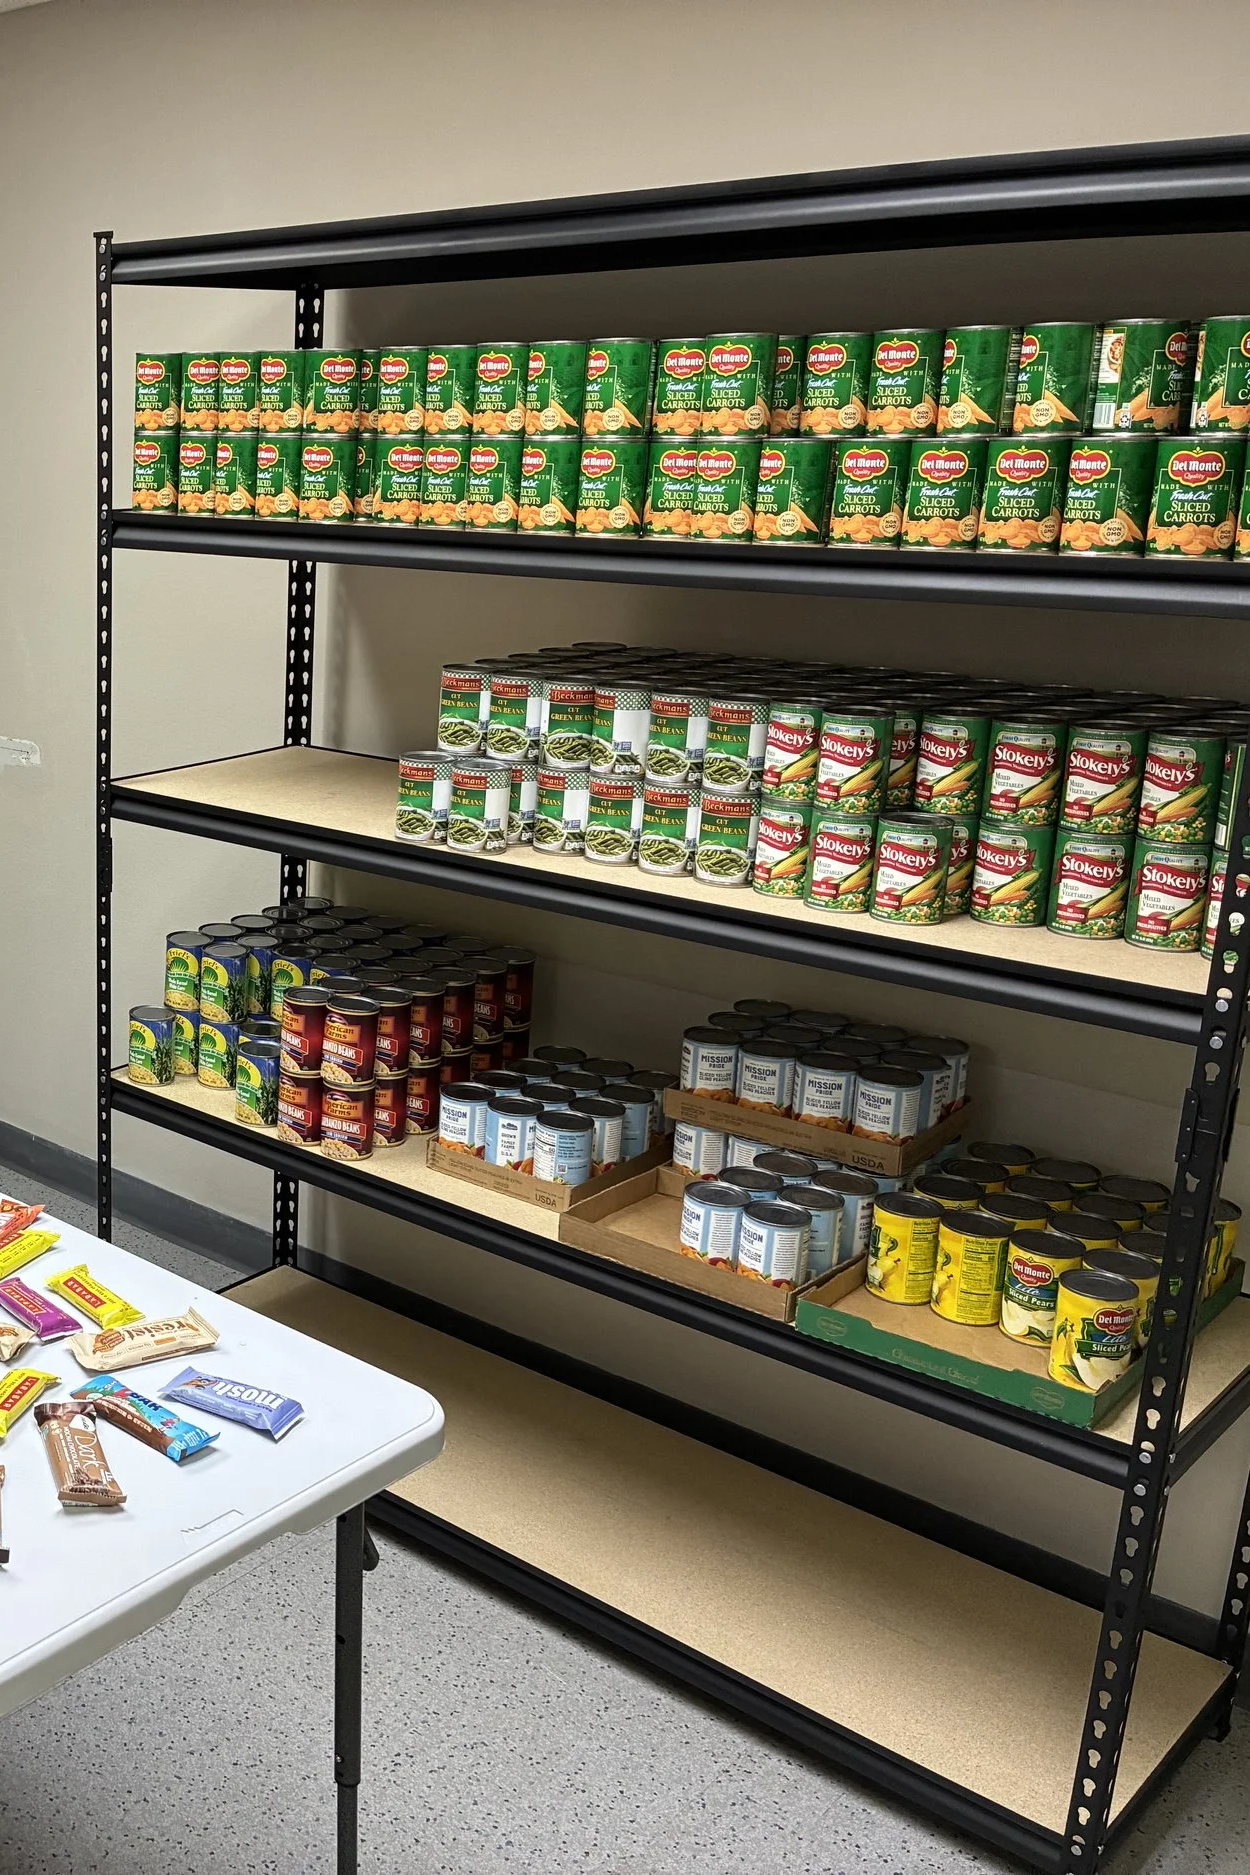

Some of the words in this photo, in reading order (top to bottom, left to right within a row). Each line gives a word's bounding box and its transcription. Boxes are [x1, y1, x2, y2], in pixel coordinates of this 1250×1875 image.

[712, 354, 723, 363] Del
[724, 353, 748, 363] Monte
[877, 351, 888, 360] Del
[889, 350, 916, 360] Monte
[323, 364, 334, 373] Del
[335, 364, 355, 374] Monte
[711, 389, 740, 398] SLICED
[807, 388, 834, 398] SLICED
[876, 387, 906, 396] SLICED
[324, 395, 350, 403] SLICED
[706, 397, 745, 407] CARROTS
[803, 396, 839, 407] CARROTS
[872, 395, 912, 406] CARROTS
[320, 401, 353, 410] CARROTS
[845, 457, 856, 467] Del
[858, 458, 886, 468] Monte
[1000, 458, 1012, 469] Del
[1013, 459, 1046, 470] Monte
[1172, 459, 1185, 471] Del
[1186, 460, 1222, 472] Monte
[844, 494, 875, 504] SLICED
[998, 496, 1035, 508] SLICED
[838, 503, 881, 514] CARROTS
[991, 506, 1040, 518] CARROTS
[1170, 501, 1211, 512] SLICED
[1163, 511, 1216, 523] CARROTS
[821, 735, 875, 758] Stokely's
[995, 744, 1055, 771] Stokely's
[1069, 751, 1131, 778] Stokely's
[704, 799, 751, 813] Beckmans
[723, 826, 748, 835] BEANS
[816, 834, 871, 859] Stokely's
[880, 844, 937, 869] Stokely's
[1061, 854, 1124, 881] Stokely's
[1141, 865, 1206, 892] Stokely's
[338, 1047, 356, 1060] BEANS
[701, 1054, 734, 1063] MISSION
[744, 1064, 777, 1077] MISSION
[807, 1079, 843, 1091] MISSION
[815, 1088, 833, 1096] PRIDE
[859, 1090, 892, 1106] MISSION
[865, 1101, 882, 1110] PRIDE
[442, 1106, 468, 1119] MISSION
[343, 1122, 361, 1135] BEANS
[851, 1154, 885, 1171] USDA
[534, 1193, 557, 1208] USDA
[1013, 1261, 1024, 1271] Del
[1024, 1266, 1051, 1280] Monte
[66, 1280, 102, 1307] LARABAR
[1015, 1283, 1040, 1295] Lite
[4, 1288, 40, 1312] LARABAR
[1009, 1287, 1029, 1302] Sliced
[1031, 1297, 1054, 1308] Pears
[1098, 1315, 1112, 1324] Del
[125, 1321, 187, 1341] resist
[1092, 1343, 1117, 1352] Sliced
[3, 1376, 38, 1408] LARABAR
[212, 1381, 285, 1410] mosh
[75, 1432, 107, 1470] Dark
